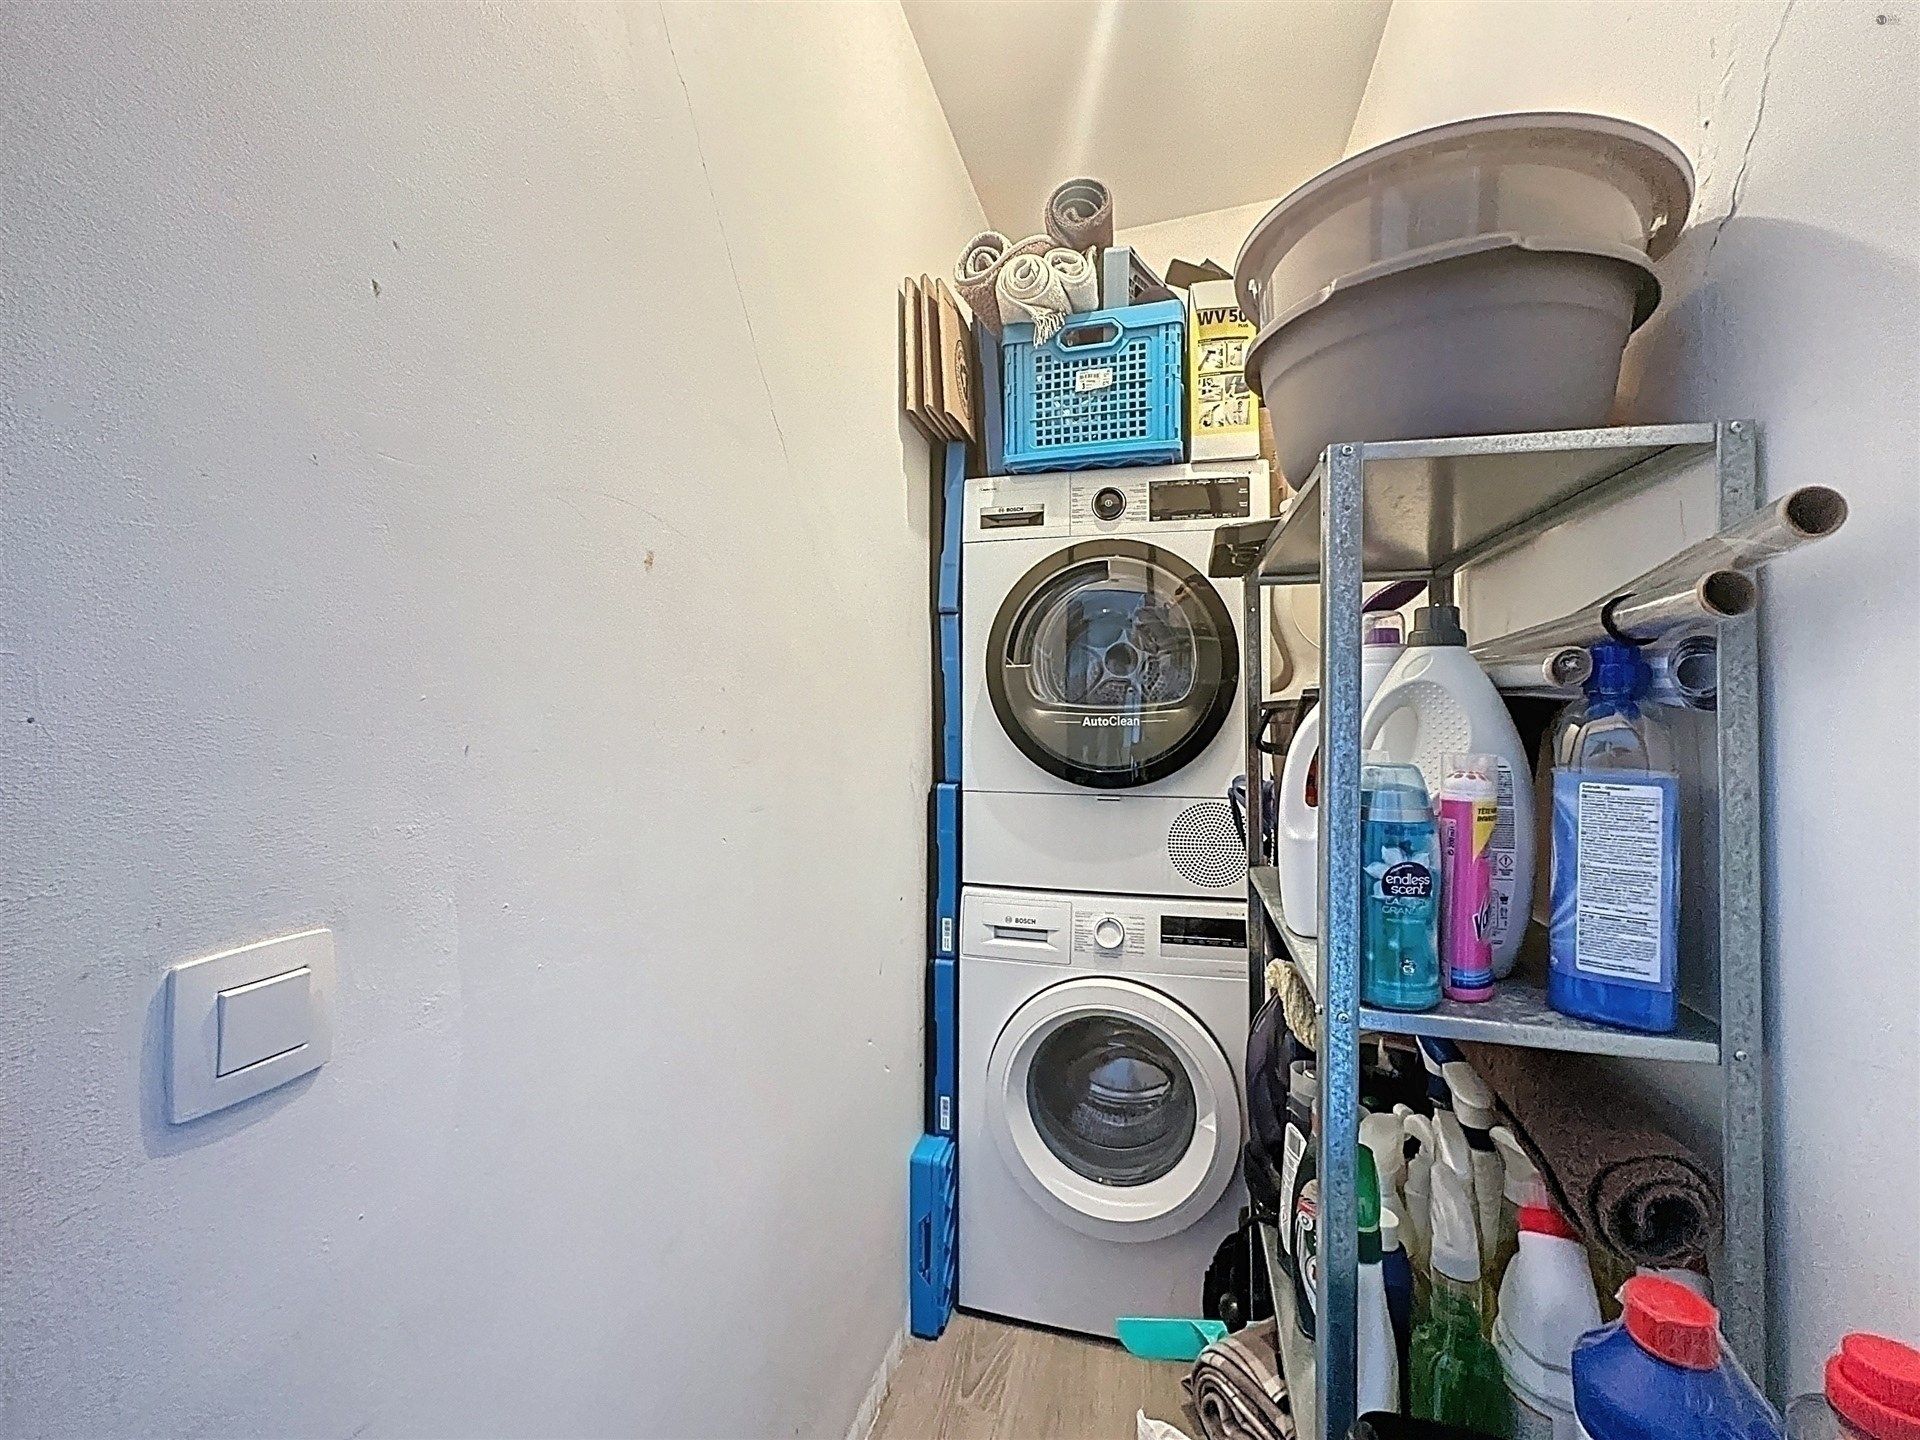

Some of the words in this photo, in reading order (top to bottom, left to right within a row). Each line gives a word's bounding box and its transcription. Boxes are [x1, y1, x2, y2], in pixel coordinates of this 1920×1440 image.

[1197, 309, 1226, 326] WV
[1082, 715, 1140, 727] AutoClean
[1386, 873, 1430, 885] endless
[1391, 884, 1426, 895] scent
[1014, 917, 1036, 925] BOSCH
